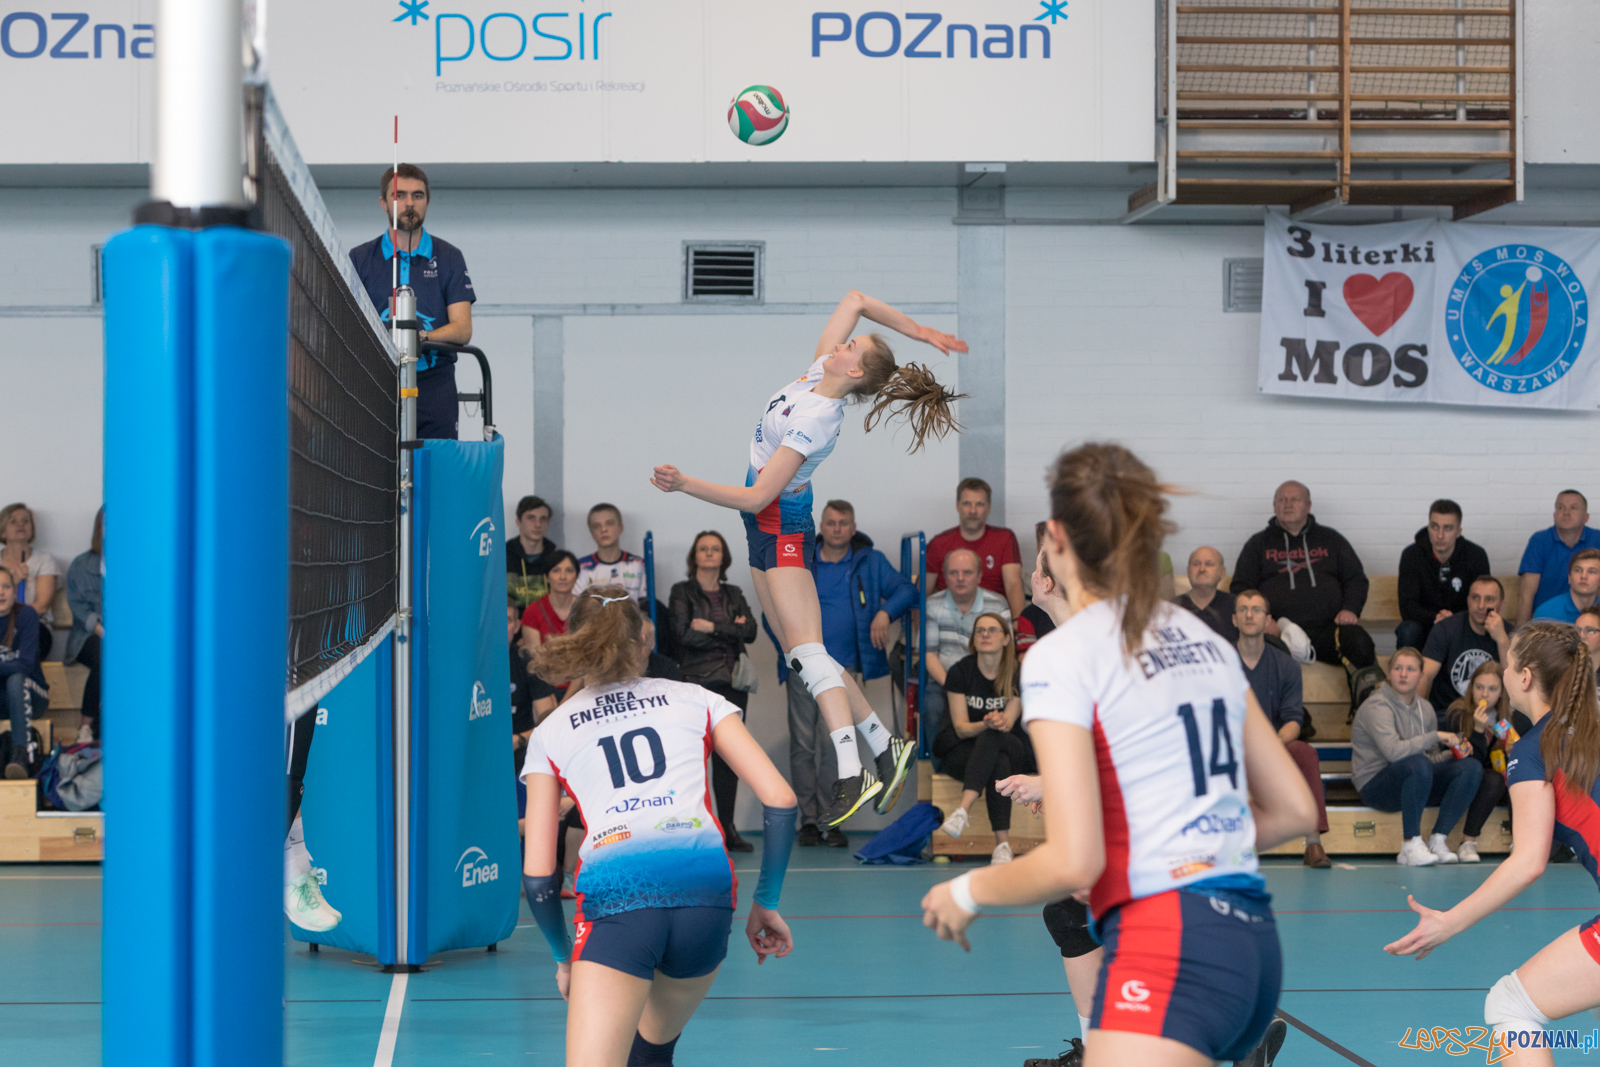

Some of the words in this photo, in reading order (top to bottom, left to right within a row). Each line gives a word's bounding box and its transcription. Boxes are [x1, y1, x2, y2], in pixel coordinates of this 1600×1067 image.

[0, 12, 156, 59] OZna
[436, 0, 612, 77] posir
[436, 81, 500, 93] Poznańskie
[503, 80, 547, 92] Ośrodki
[550, 80, 587, 93] Sportu
[595, 80, 645, 93] Rekreacji
[753, 92, 771, 115] molten
[1287, 226, 1316, 259] 3
[1321, 241, 1435, 265] literki
[1303, 279, 1327, 318] I
[1447, 259, 1483, 320] UMKS
[1496, 246, 1544, 263] MOS
[1556, 262, 1586, 328] WOLA
[1278, 337, 1429, 388] MOS
[1460, 351, 1571, 393] WARSZAWA
[755, 416, 763, 443] nea
[1265, 546, 1329, 562] Reebok
[469, 698, 492, 721] Enea
[569, 695, 669, 729] ENERGETYK
[594, 691, 636, 706] ENEA
[966, 695, 984, 709] AD
[985, 697, 1007, 710] SEE
[597, 726, 666, 789] 10
[1177, 697, 1238, 798] 14
[605, 794, 674, 814] OZnan
[592, 824, 628, 842] AKROPOL
[462, 863, 498, 887] Enea
